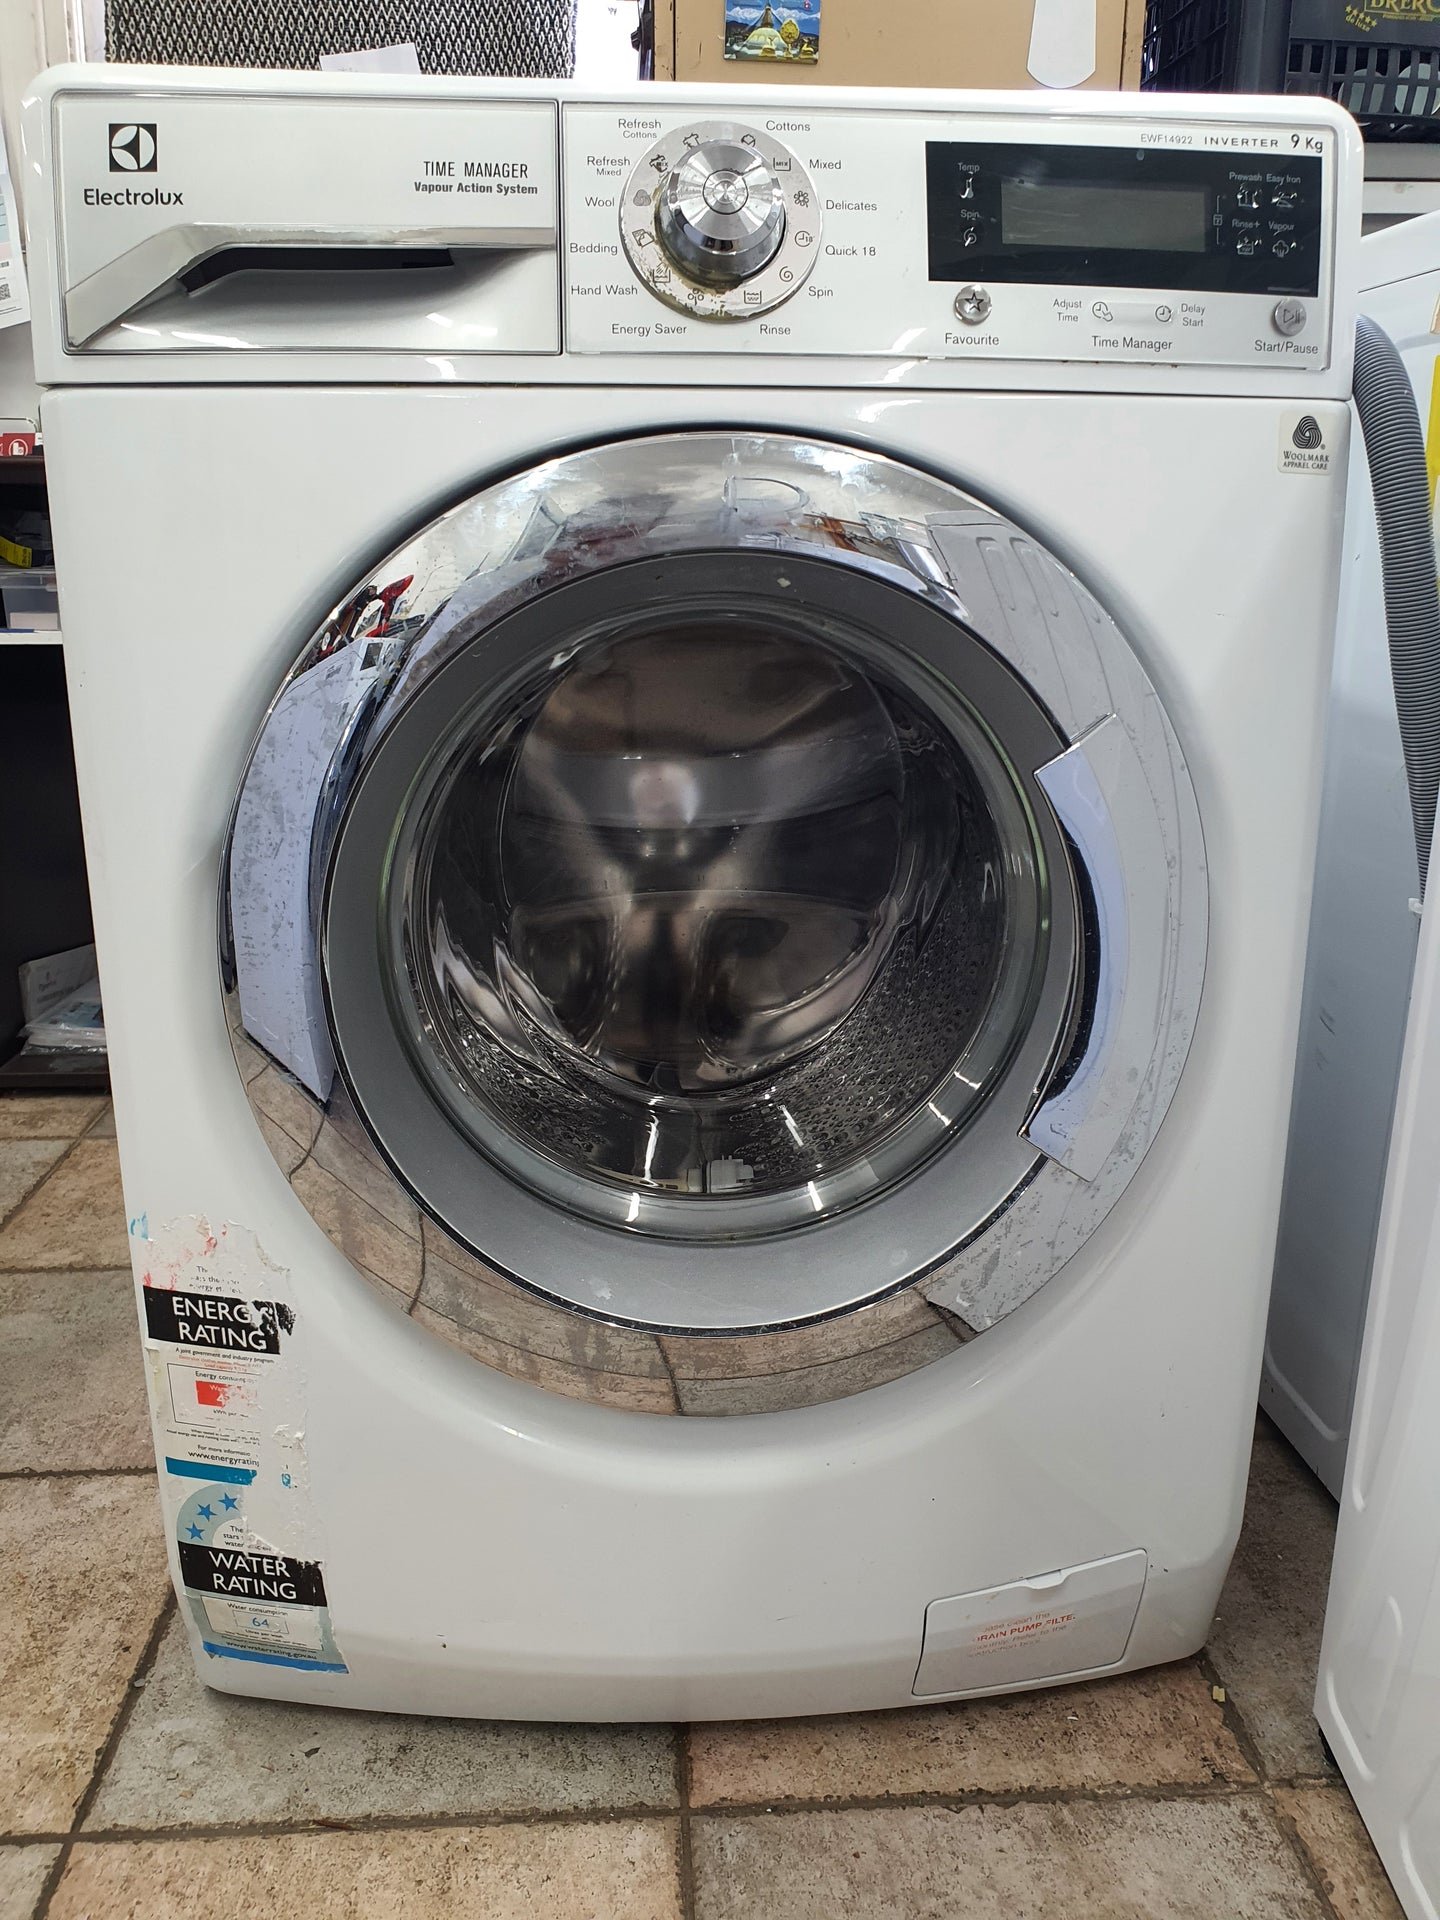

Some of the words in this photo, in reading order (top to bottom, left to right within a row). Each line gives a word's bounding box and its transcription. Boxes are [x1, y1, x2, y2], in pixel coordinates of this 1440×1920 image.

[618, 119, 661, 130] Refresh
[766, 121, 811, 132] Cottons
[623, 131, 657, 139] Cottons
[1140, 134, 1193, 145] EWF14922
[1204, 136, 1279, 148] INVERTER
[1291, 134, 1300, 149] 9
[1305, 137, 1323, 153] Kg
[587, 156, 630, 167] Refresh
[809, 158, 842, 170] Mixed
[958, 162, 980, 173] Temp
[424, 161, 455, 177] TIME
[464, 162, 528, 178] MANAGER
[596, 168, 621, 176] Mixed
[1229, 171, 1262, 181] Prewash
[1266, 173, 1284, 186] Easy
[1287, 175, 1301, 184] Iron
[414, 181, 453, 194] Vapour
[457, 182, 492, 193] Action
[496, 184, 538, 195] System
[83, 188, 183, 206] Electrolux
[585, 197, 615, 207] Wool
[826, 200, 877, 211] Delicates
[960, 209, 979, 220] Spin
[1231, 218, 1260, 228] Rinse+
[1268, 221, 1294, 231] Vapour
[570, 243, 618, 255] Bedding
[825, 245, 856, 257] Quick
[862, 246, 876, 256] 18
[571, 285, 601, 296] Hand
[605, 285, 638, 296] Wash
[808, 287, 834, 299] Spin
[1053, 298, 1082, 311] Adjust
[1181, 303, 1206, 316] Delay
[1057, 312, 1079, 322] Time
[1182, 317, 1204, 327] Start
[612, 324, 650, 337] Energy
[655, 323, 687, 335] Saver
[760, 324, 791, 335] Rinse
[945, 333, 1000, 347] Favourite
[1092, 336, 1119, 348] Time
[1123, 337, 1173, 352] Manager
[1254, 340, 1319, 355] Start/Pause
[1283, 461, 1310, 469] APPAREL
[172, 1297, 262, 1324] ENERG
[178, 1321, 267, 1351] RATING
[192, 1350, 221, 1358] government
[195, 1371, 217, 1380] Energy
[230, 1525, 244, 1533] The
[209, 1550, 291, 1578] WATER
[212, 1573, 297, 1600] RATING
[227, 1602, 247, 1610] Water
[252, 1617, 269, 1627] 64
[977, 1630, 1007, 1642] RAIN
[1010, 1622, 1043, 1636] PUMP
